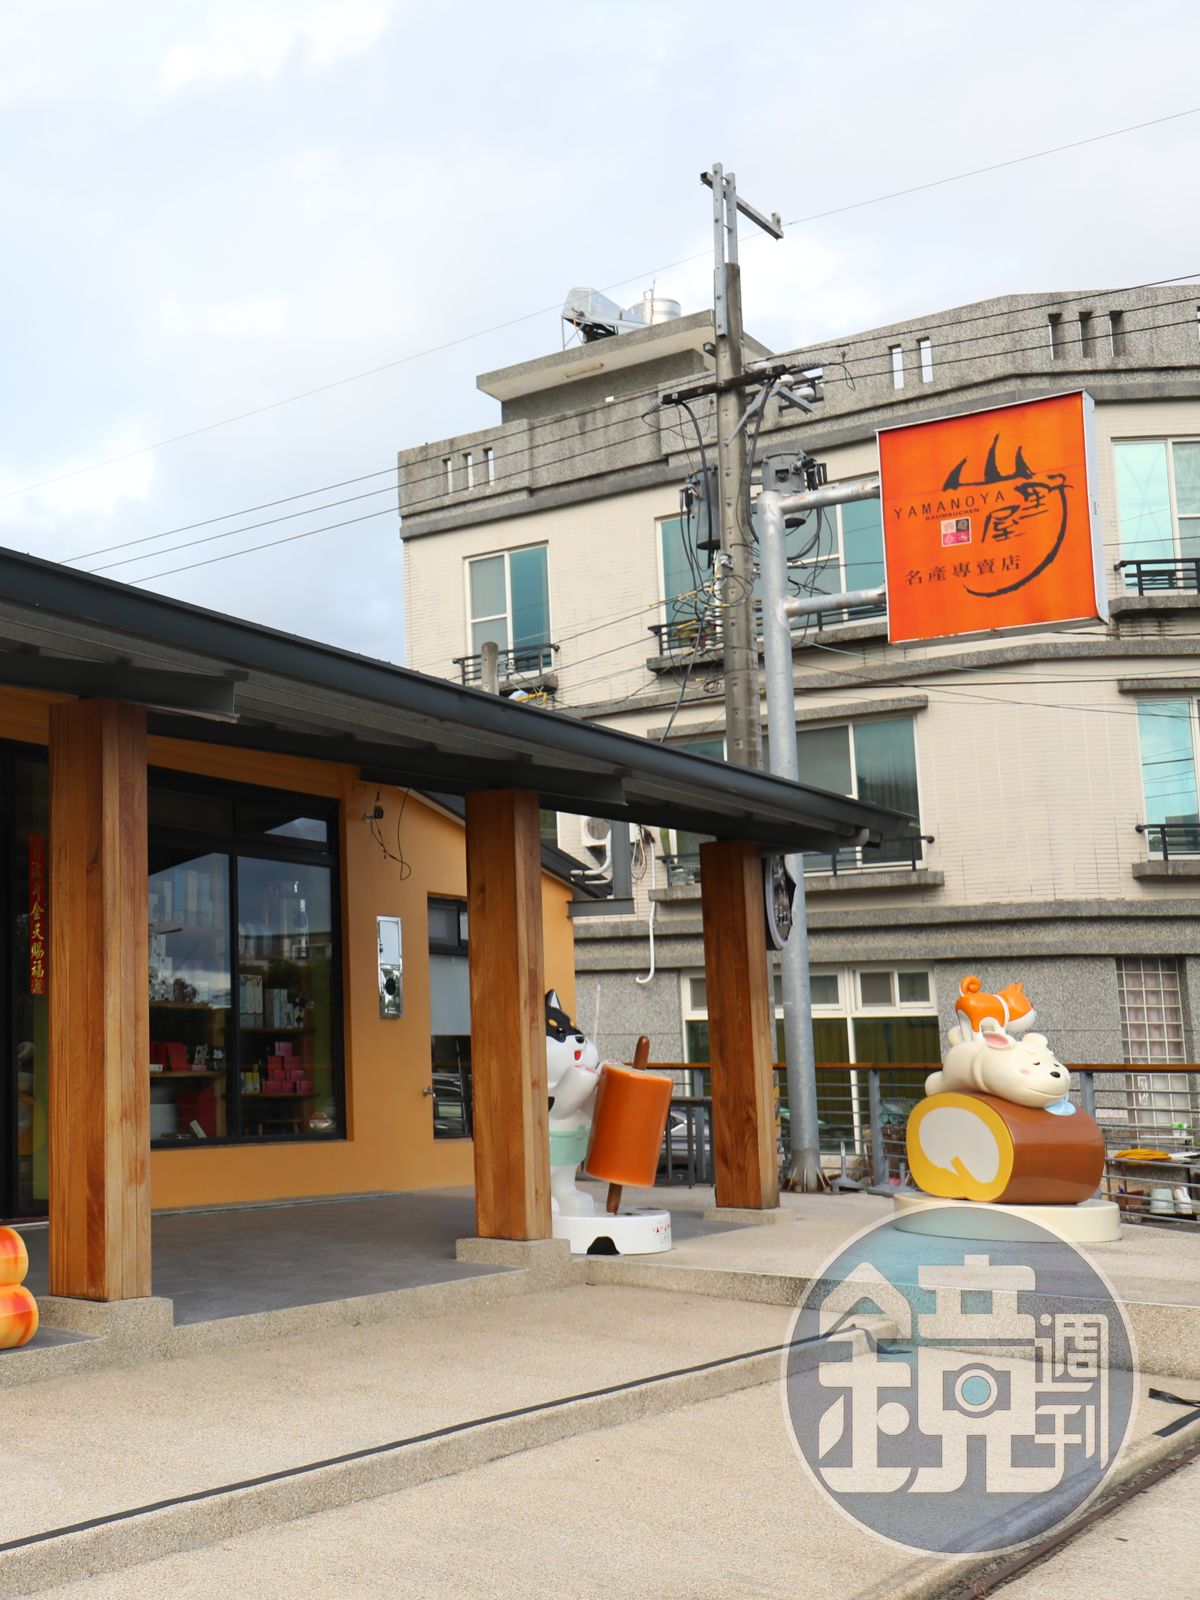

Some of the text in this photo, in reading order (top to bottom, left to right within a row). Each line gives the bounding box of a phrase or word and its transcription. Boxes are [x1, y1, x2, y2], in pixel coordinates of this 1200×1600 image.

[894, 490, 1006, 520] YAMANOYA
[925, 507, 980, 521] BAUMKUCHEN
[904, 554, 1022, 586] 名產專賣店
